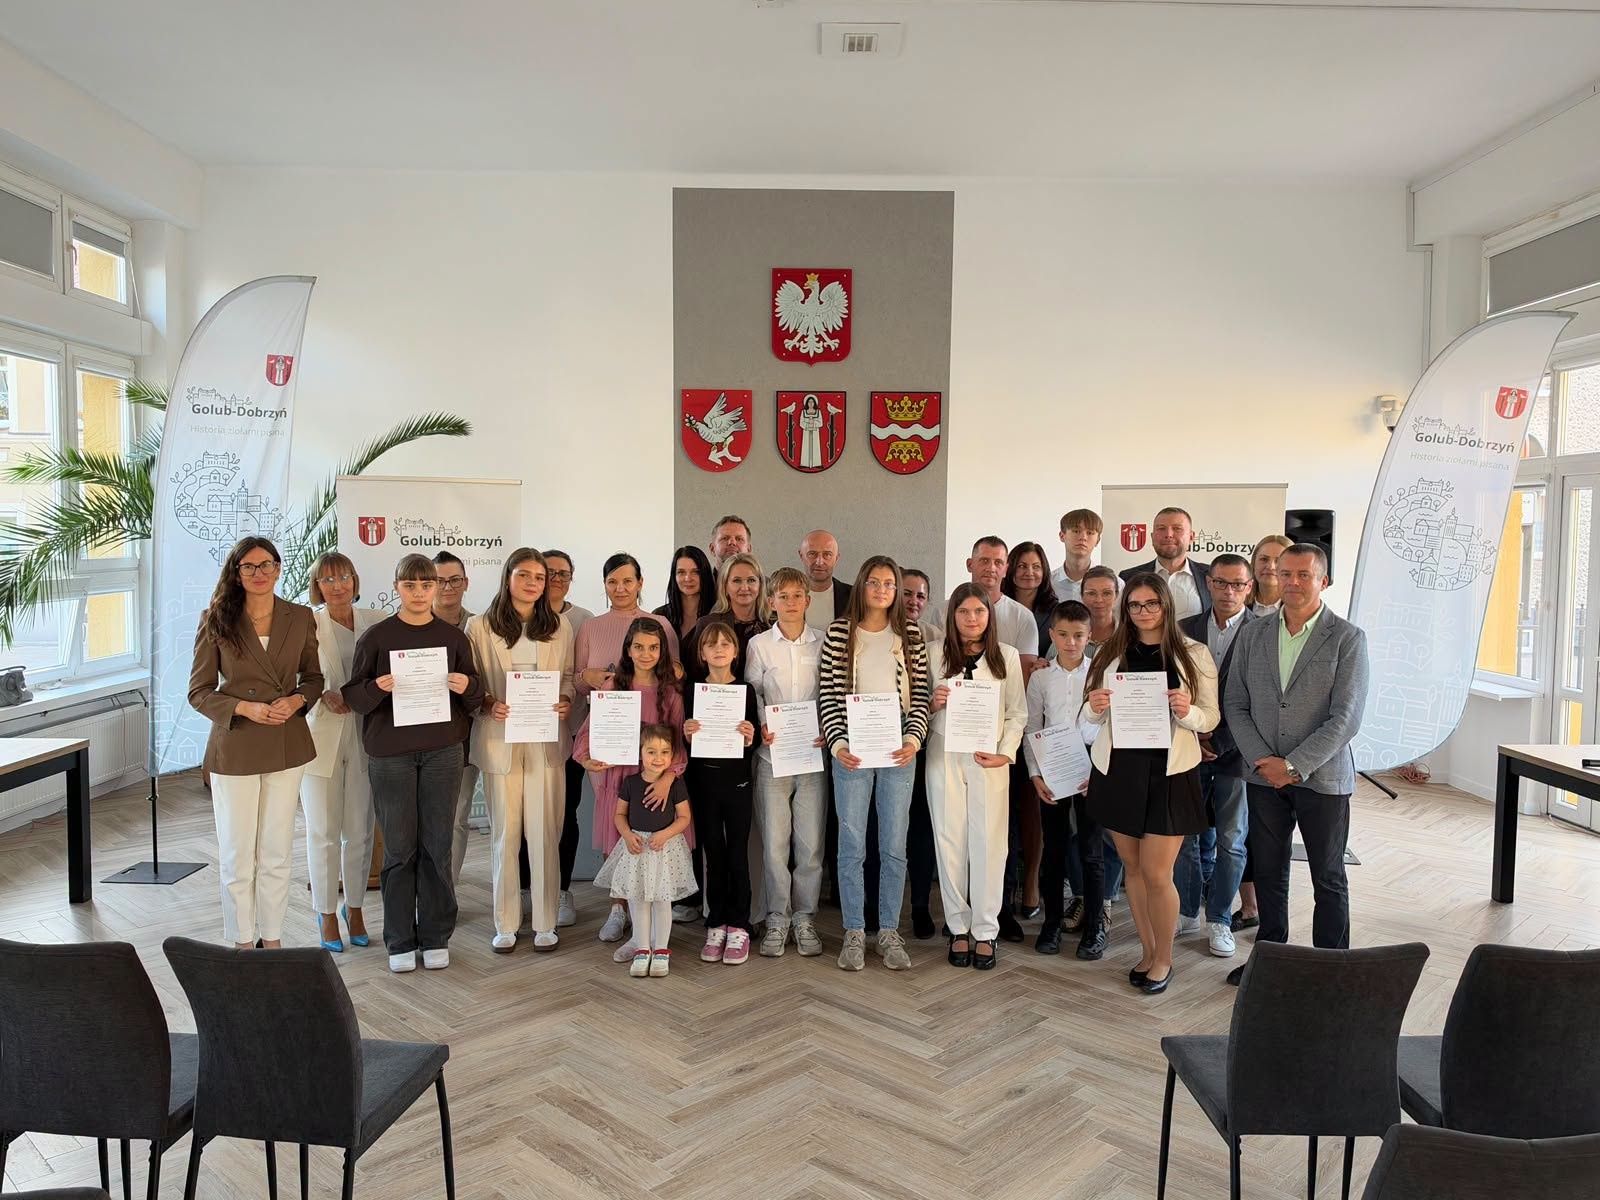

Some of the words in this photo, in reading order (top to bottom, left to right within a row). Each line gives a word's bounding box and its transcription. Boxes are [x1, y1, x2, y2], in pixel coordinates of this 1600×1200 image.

[191, 404, 287, 421] Golub-Dobrzyń
[190, 425, 225, 434] Historia
[1415, 432, 1515, 454] Golub-Dobrzyń
[1410, 451, 1443, 463] Historia
[400, 535, 502, 549] Golub-Dobrzyń
[472, 557, 502, 568] pisana
